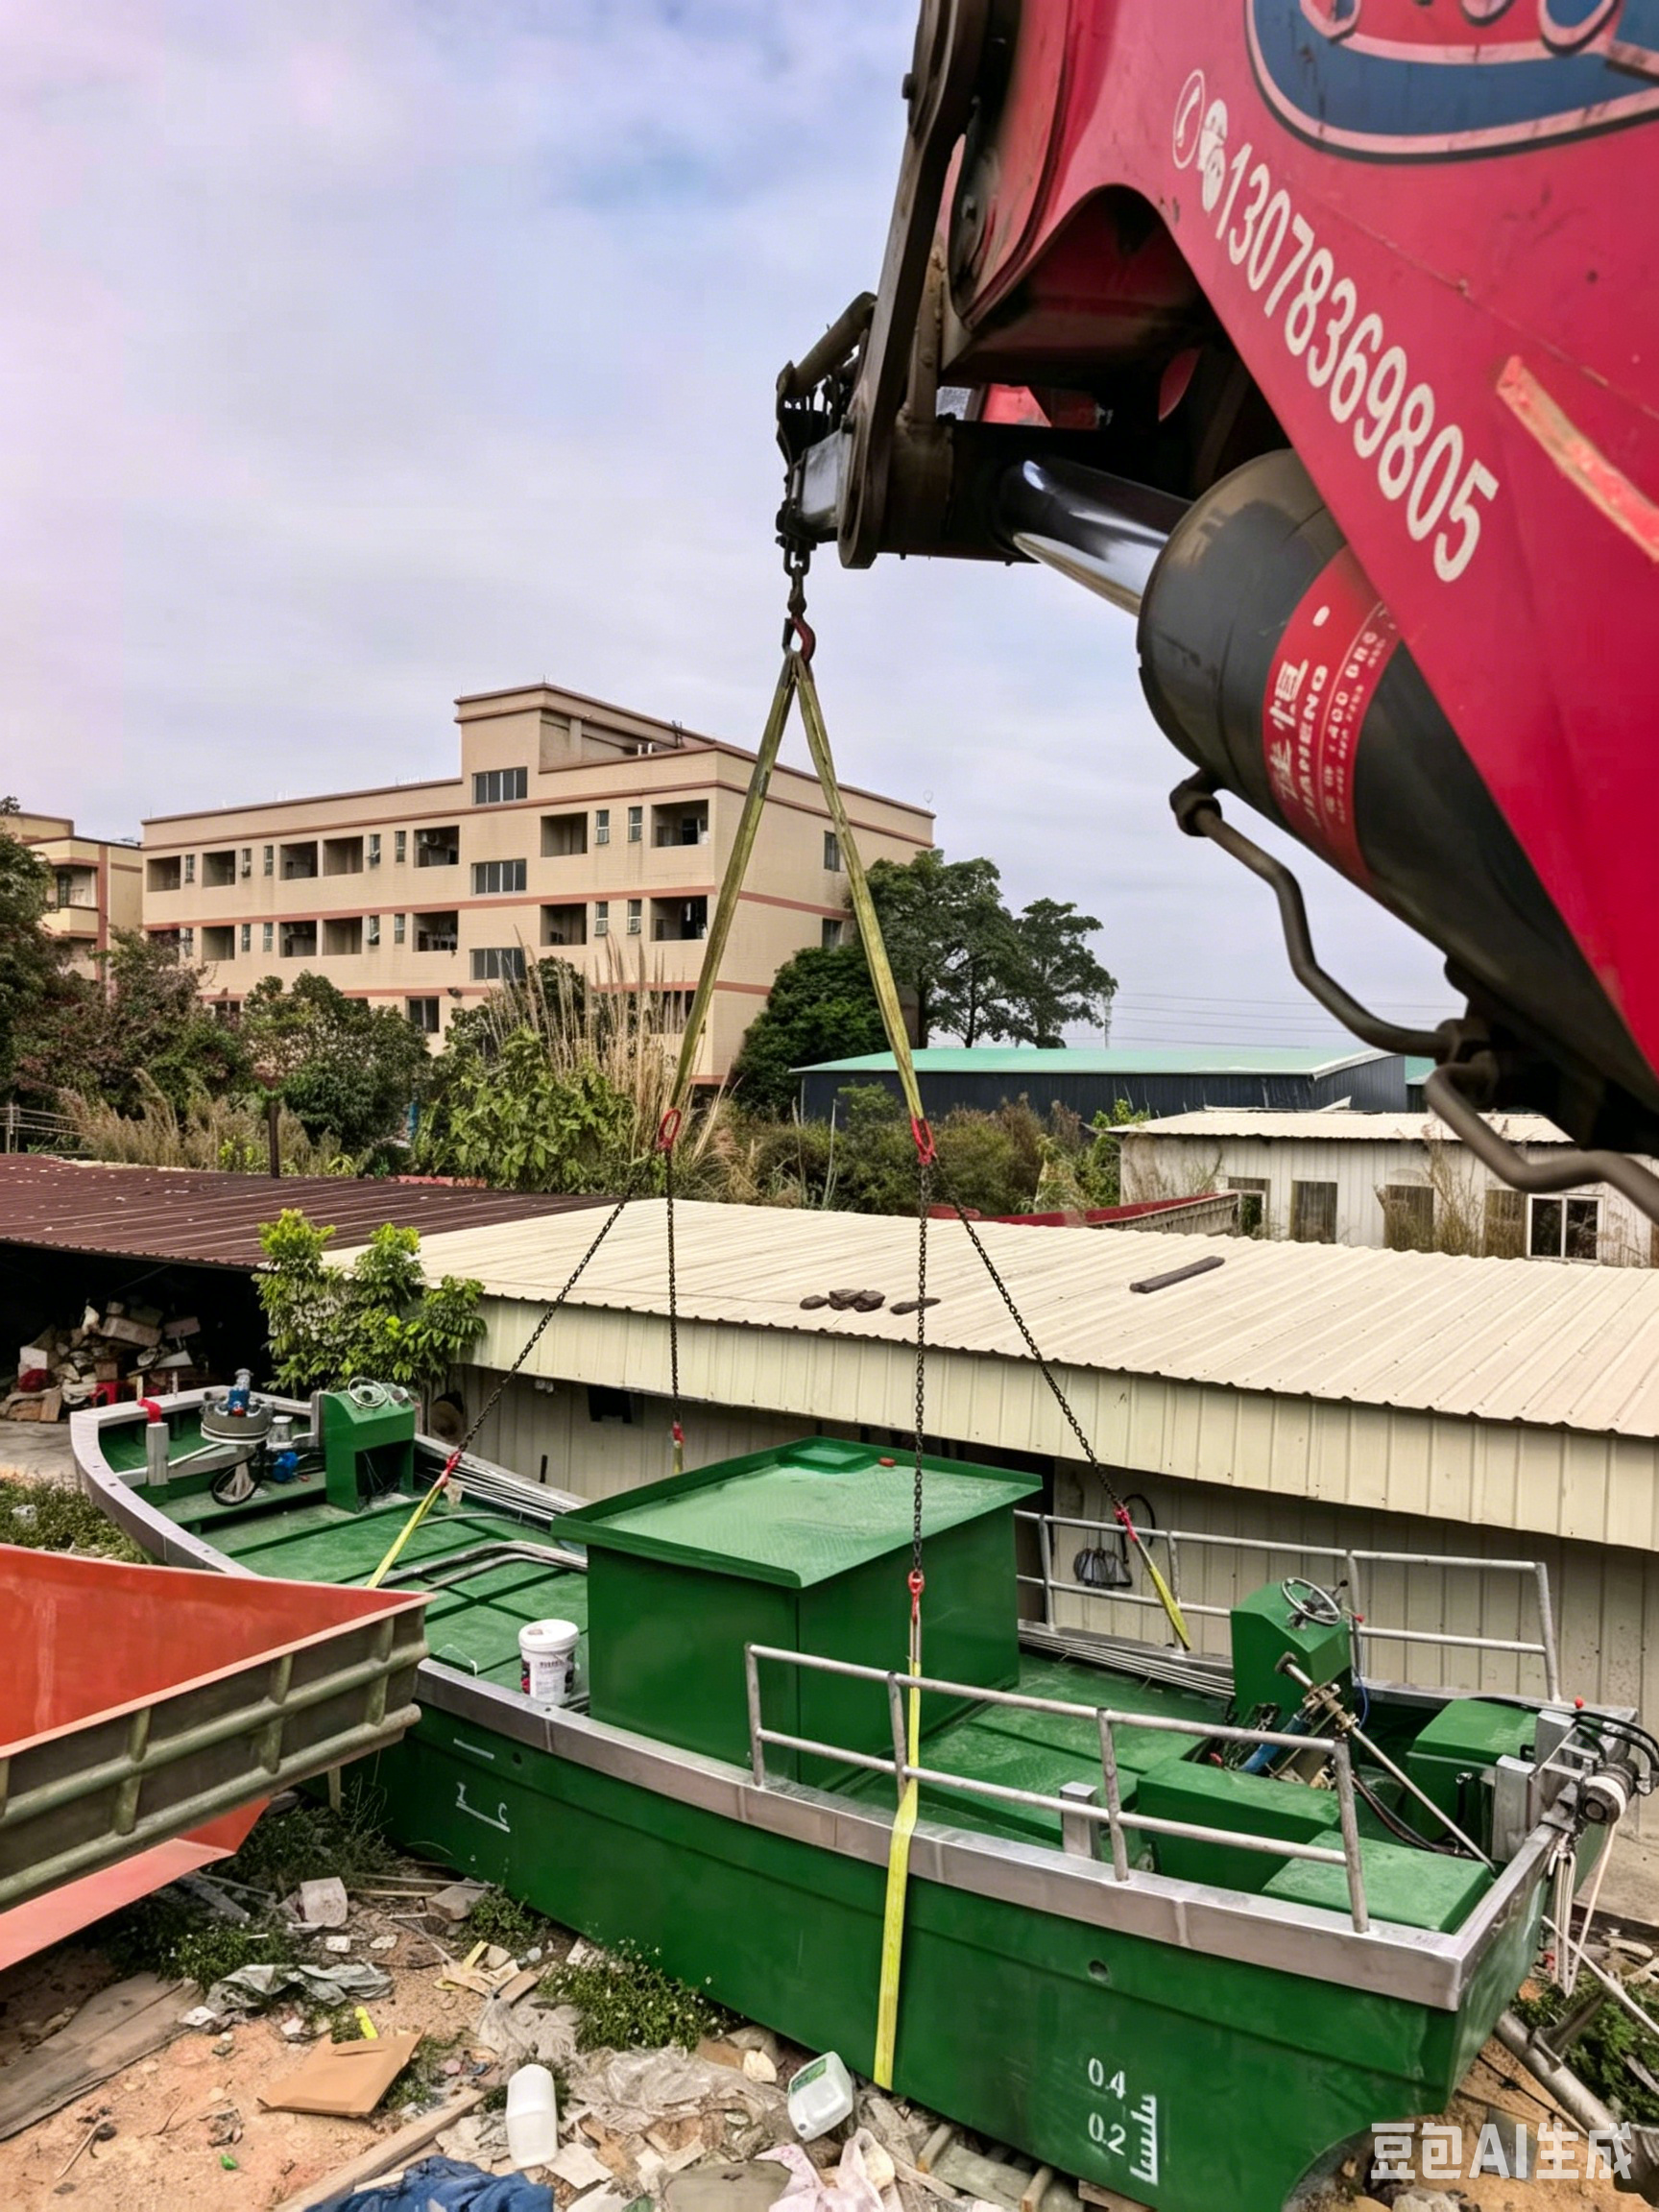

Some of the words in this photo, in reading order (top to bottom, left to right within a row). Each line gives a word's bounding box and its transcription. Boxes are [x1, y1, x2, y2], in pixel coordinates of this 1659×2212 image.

[1214, 143, 1499, 583] 13078369805
[1088, 2057, 1126, 2100] 0.4
[1088, 2112, 1126, 2156] 0.2
